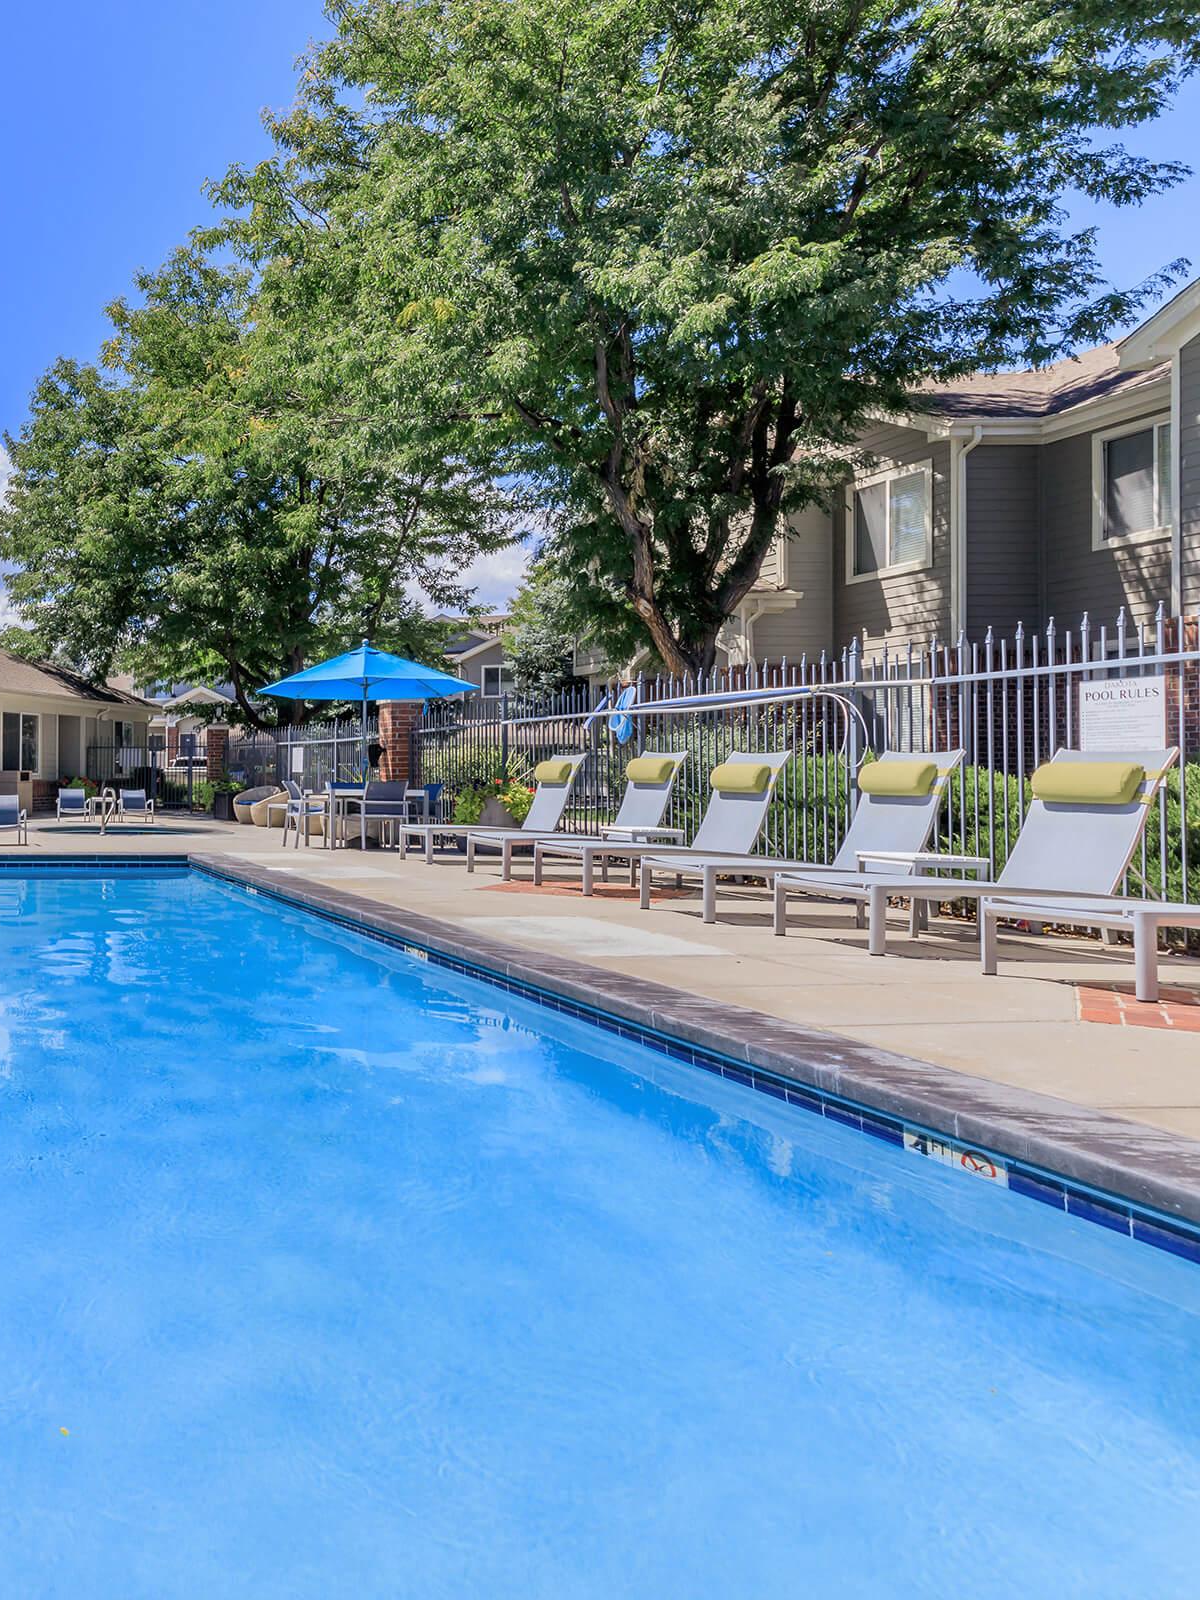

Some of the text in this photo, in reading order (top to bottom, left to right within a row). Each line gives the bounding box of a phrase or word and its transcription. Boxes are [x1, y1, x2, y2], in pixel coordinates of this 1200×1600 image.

[1085, 687, 1160, 702] POOL RULES
[909, 1134, 948, 1156] 4 FT
